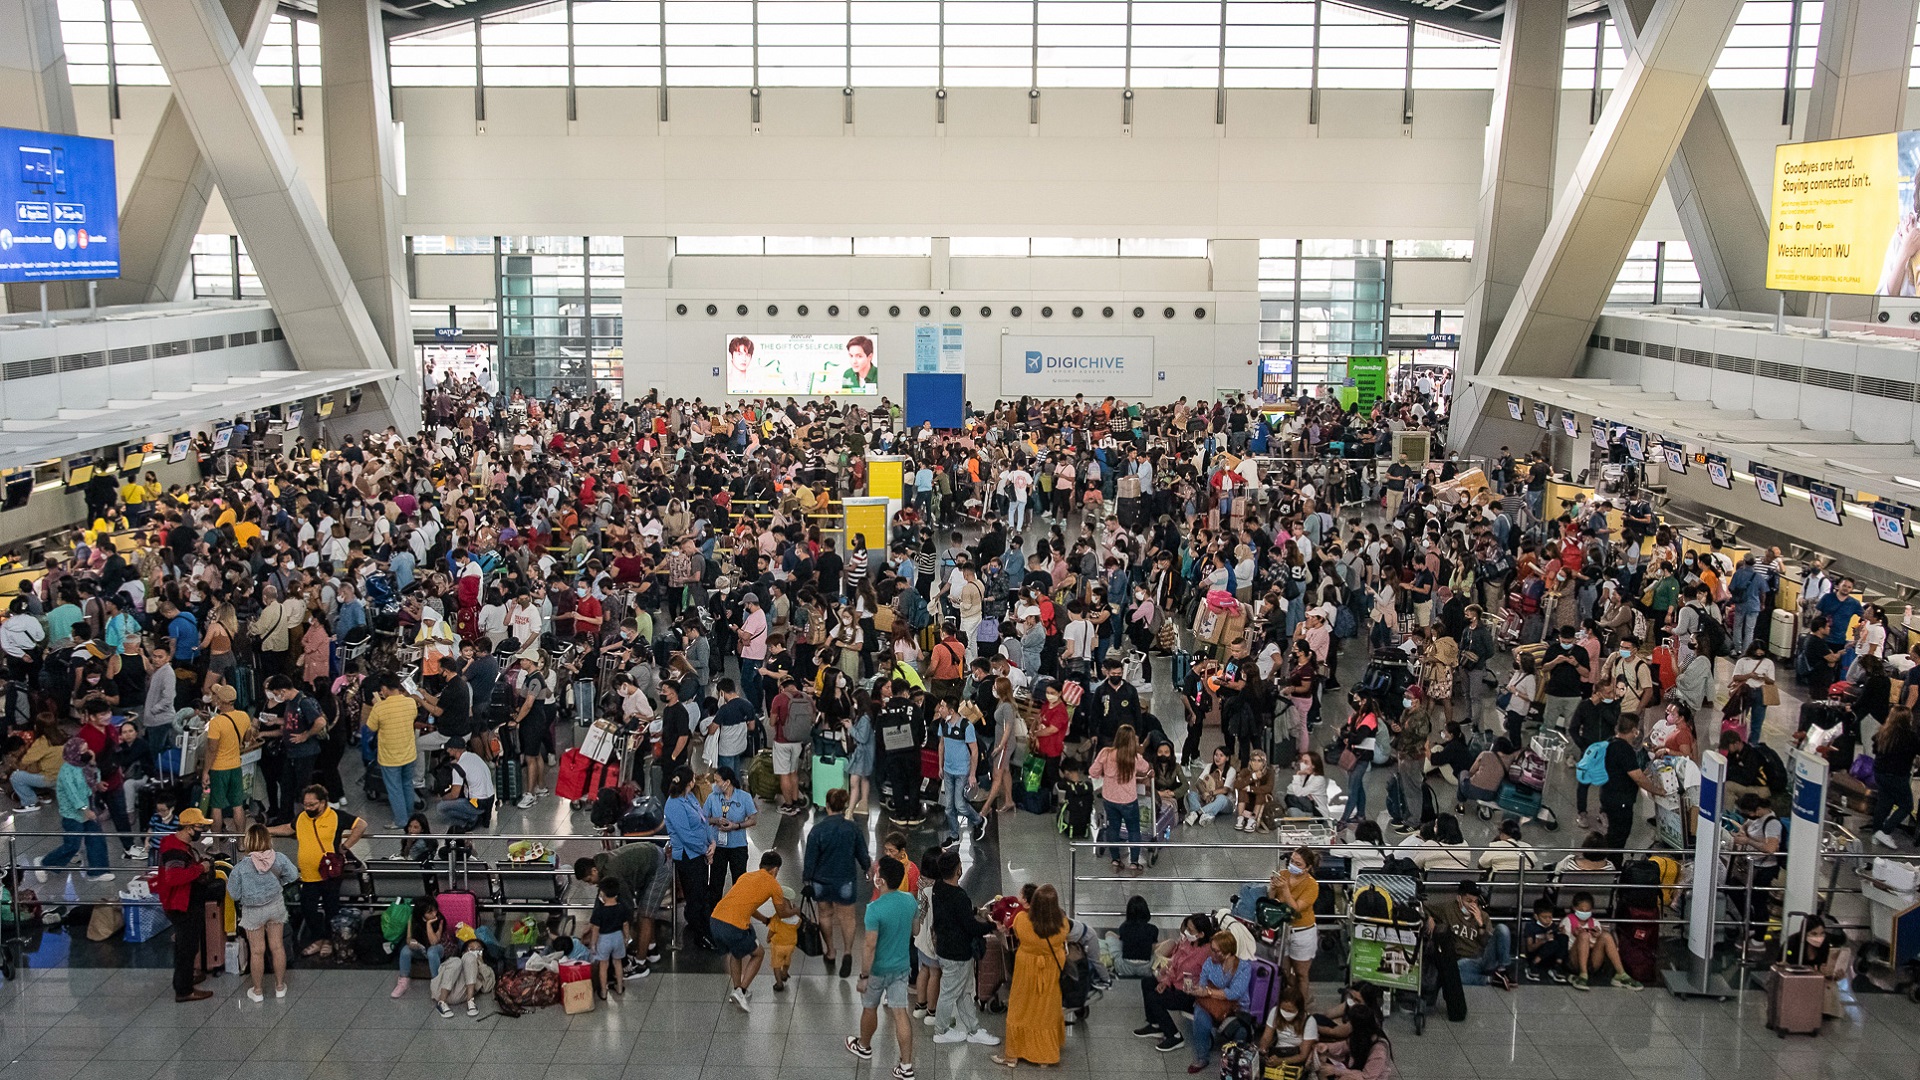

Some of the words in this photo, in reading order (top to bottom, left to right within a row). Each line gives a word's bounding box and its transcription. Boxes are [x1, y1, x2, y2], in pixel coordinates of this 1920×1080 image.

[1783, 160, 1818, 176] Goodbyes
[1820, 161, 1833, 172] are
[1834, 155, 1855, 171] hard.
[1782, 178, 1808, 194] Staying
[1810, 174, 1850, 190] connected
[1851, 172, 1871, 188] isn't.
[1778, 243, 1832, 258] WesternUnion
[1835, 243, 1850, 258] WU
[1046, 356, 1124, 369] DIGICHIVE
[1452, 924, 1478, 941] GAP
